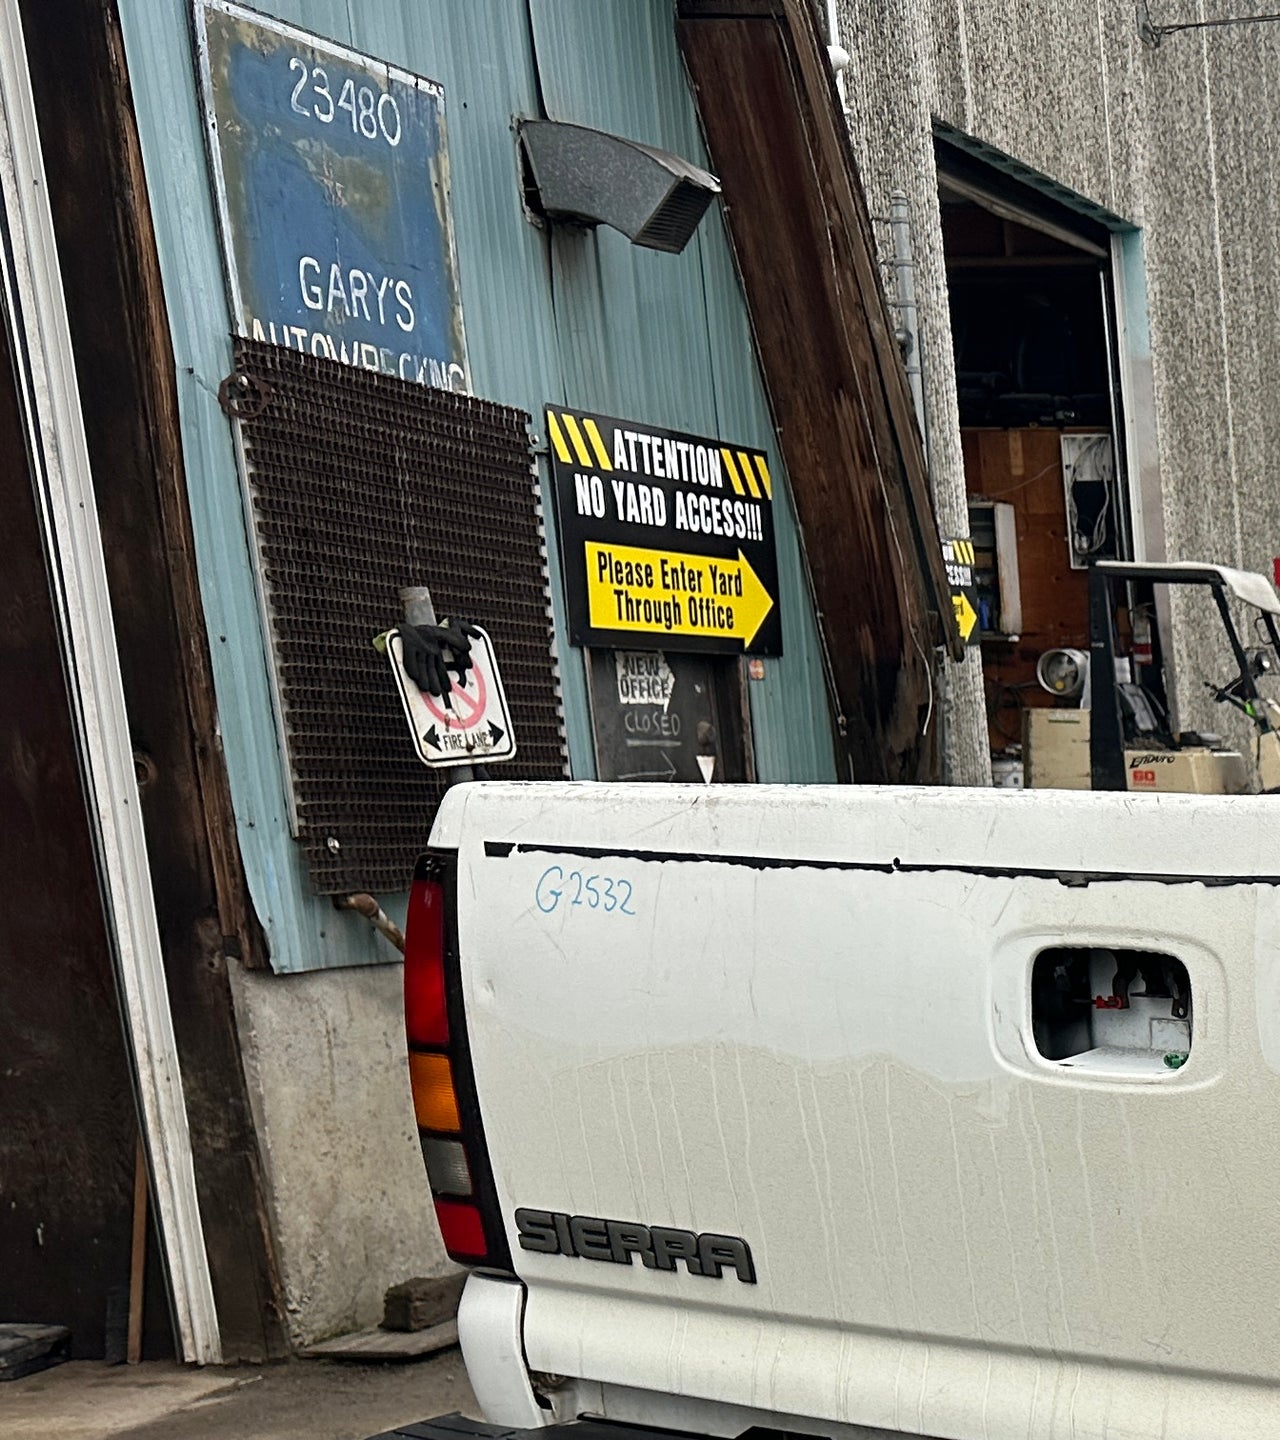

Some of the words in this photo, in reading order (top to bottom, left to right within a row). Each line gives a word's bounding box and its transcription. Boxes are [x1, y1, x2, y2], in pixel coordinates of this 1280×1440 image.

[289, 57, 401, 147] 23480
[299, 256, 415, 333] GARY'S
[613, 429, 723, 488] ATTENTION
[574, 473, 606, 518] NO
[611, 479, 667, 526] YARD
[675, 491, 763, 541] ACCESS!!!
[597, 551, 654, 588] Please
[660, 559, 703, 593] Enter
[709, 565, 743, 597] Yard
[613, 589, 682, 630] Through
[688, 596, 734, 629] Office
[619, 676, 671, 699] OFFICE
[624, 655, 661, 676] NEW
[443, 734, 465, 750] FIRE
[625, 711, 681, 736] CLOSED
[536, 866, 636, 915] G2532
[515, 1208, 757, 1284] SIERRA
